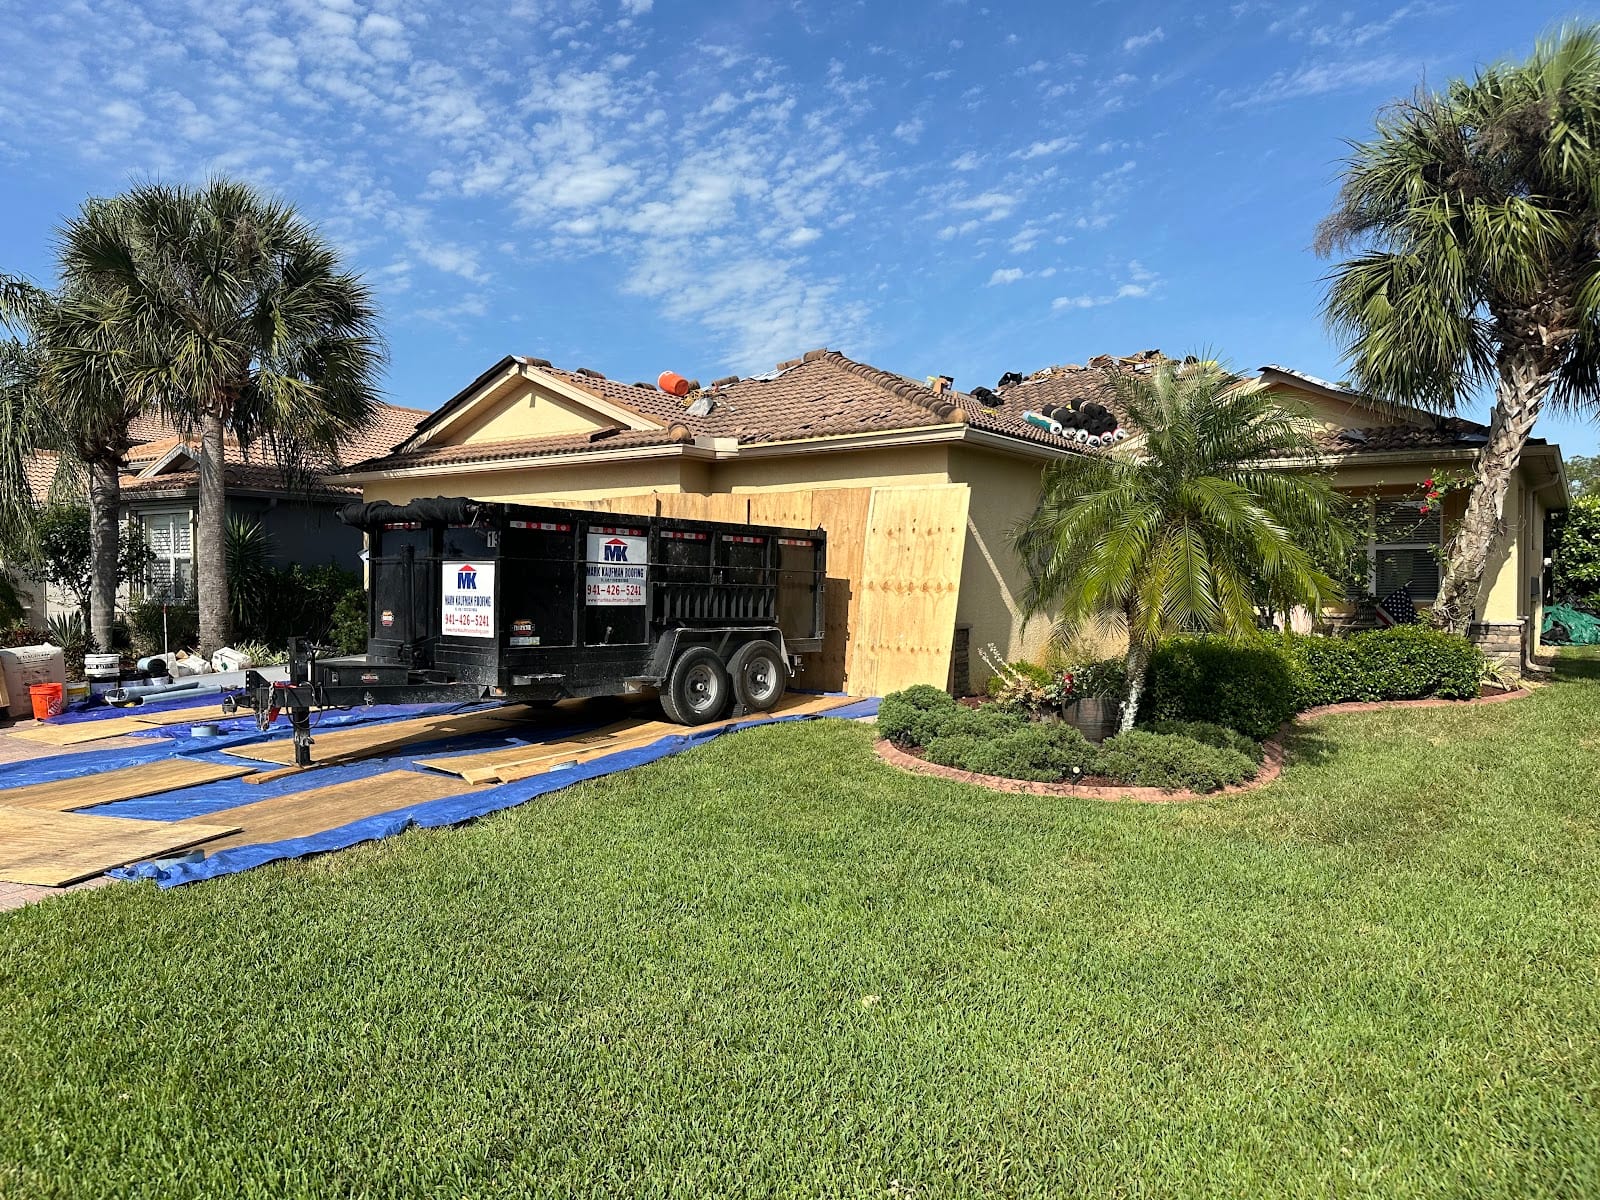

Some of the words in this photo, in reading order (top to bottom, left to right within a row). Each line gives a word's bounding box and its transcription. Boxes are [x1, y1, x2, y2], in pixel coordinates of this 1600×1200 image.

[604, 545, 628, 561] MK
[587, 566, 601, 577] MARK
[602, 567, 624, 578] KAUFMAN
[625, 568, 644, 578] ROOFING
[457, 572, 477, 590] MK
[587, 584, 641, 596] 941-426-5241
[445, 613, 490, 627] 941-426-5241
